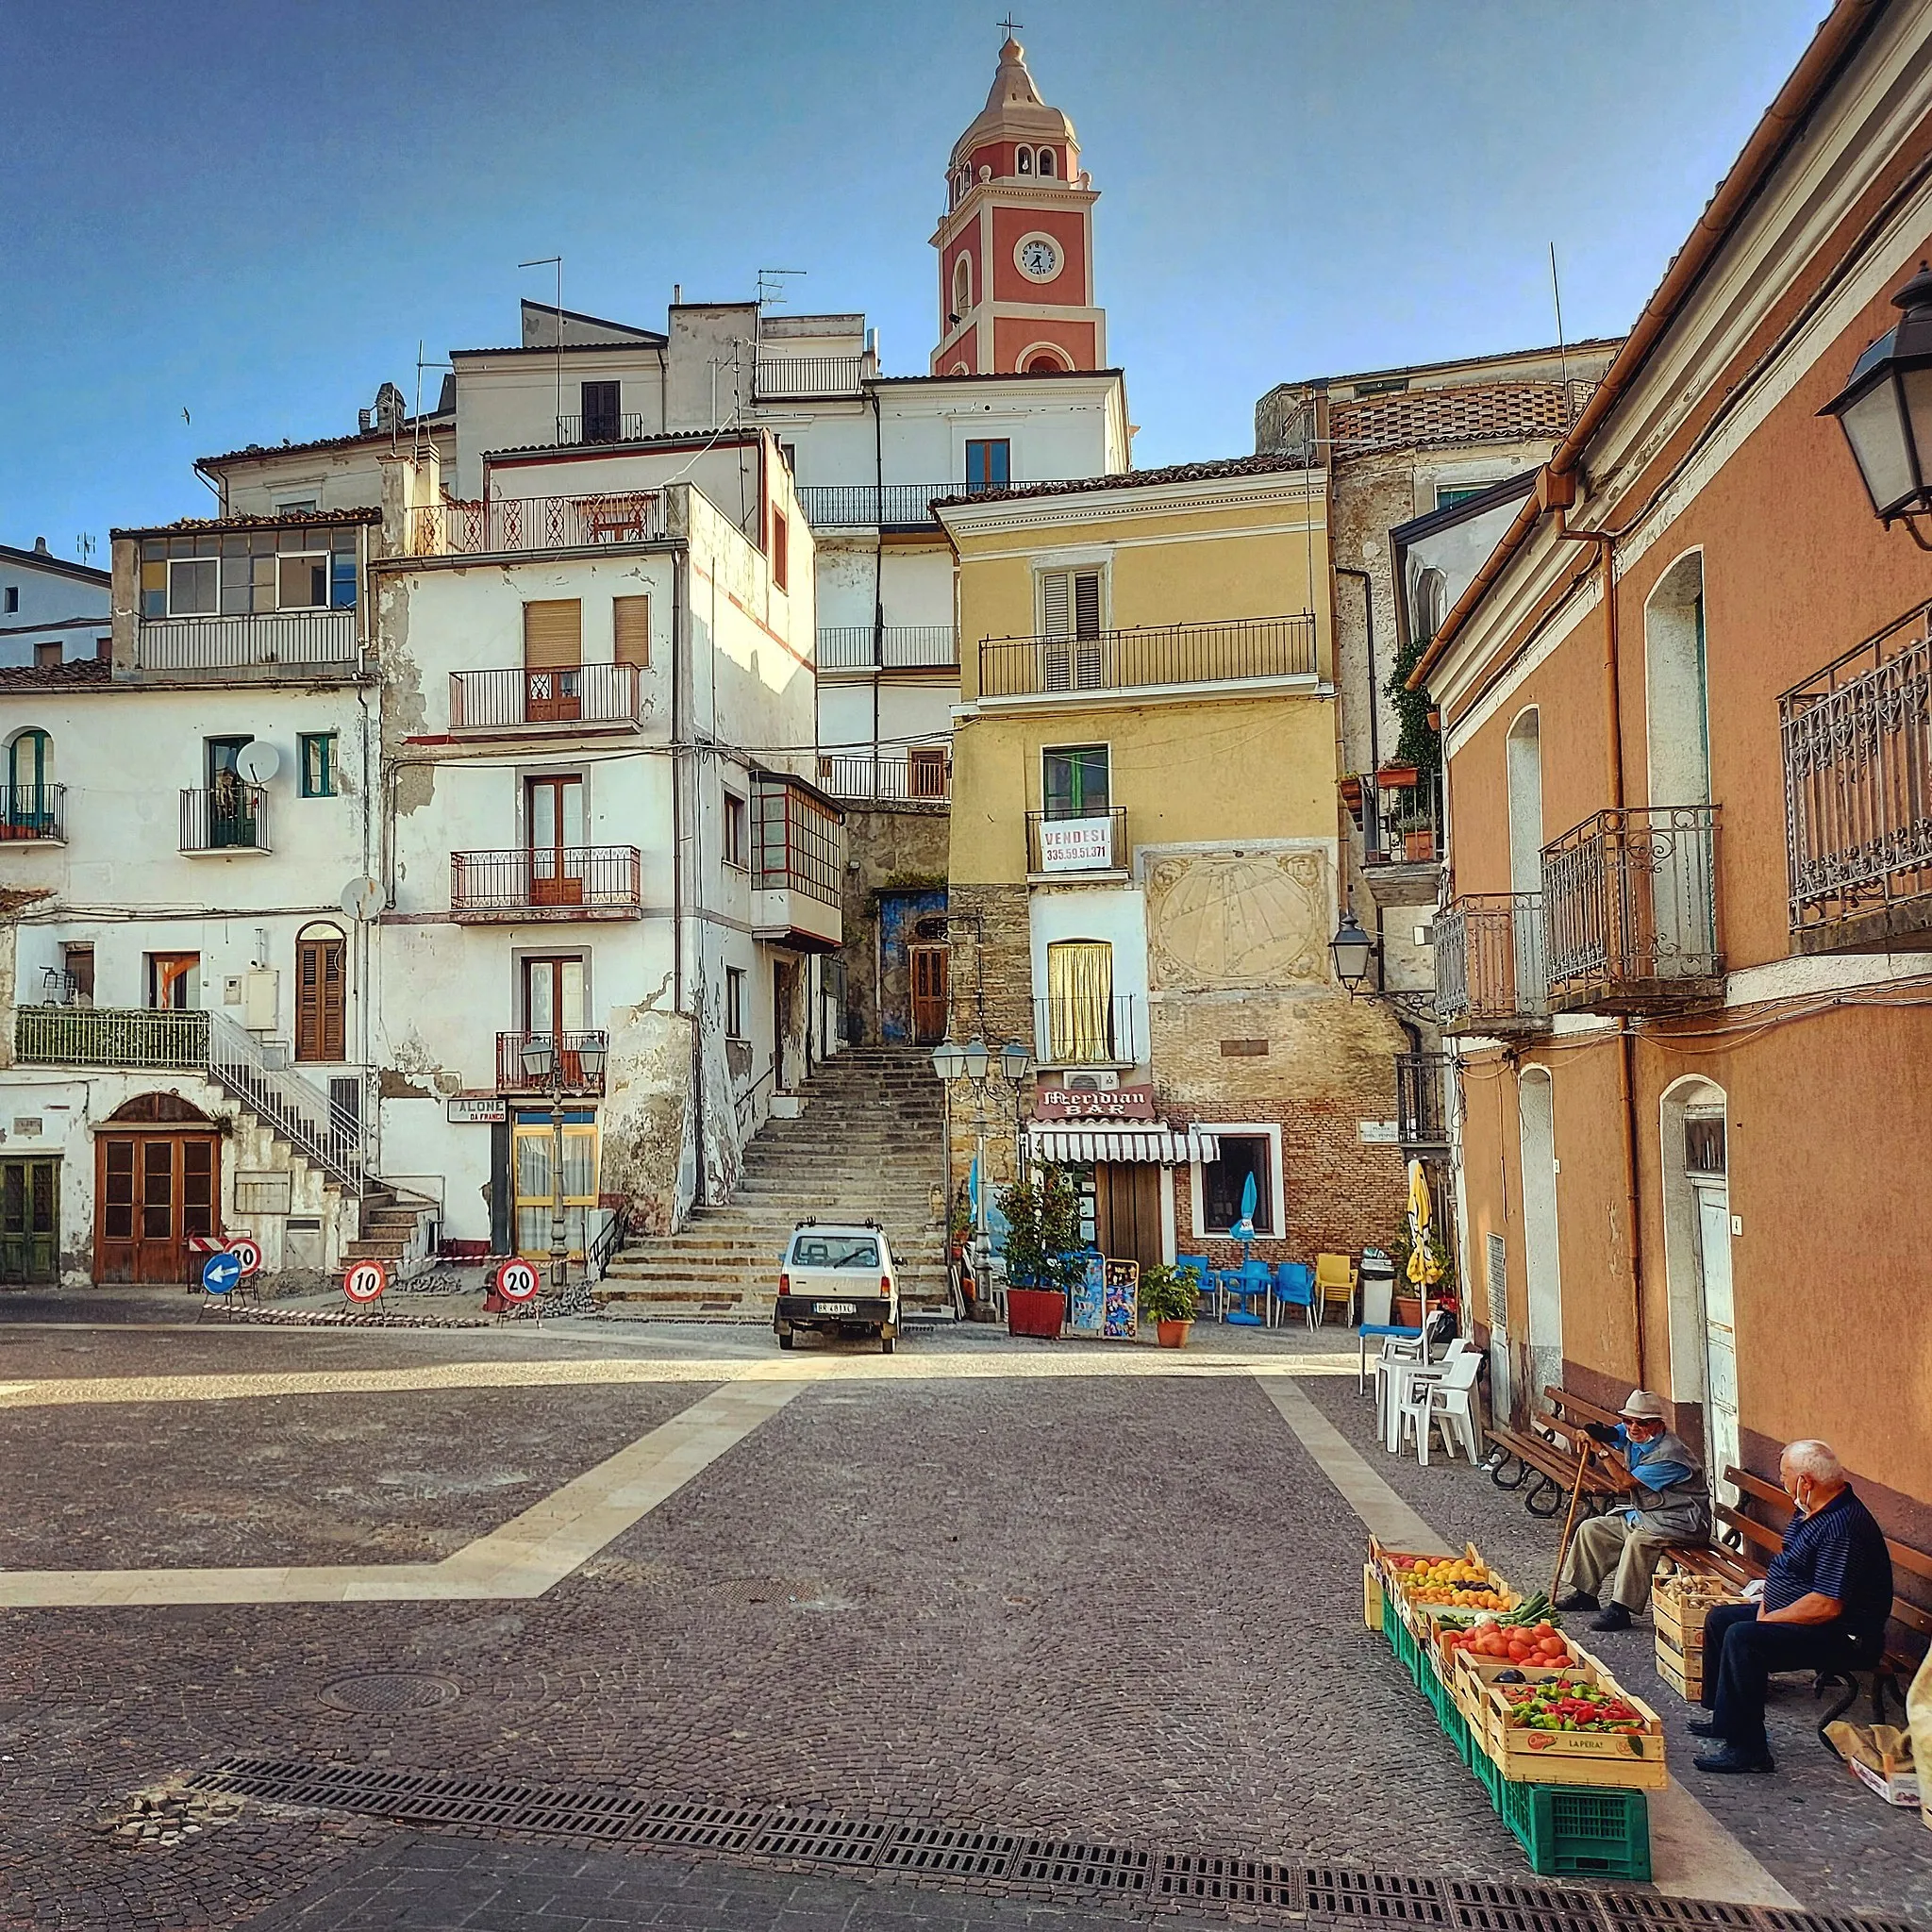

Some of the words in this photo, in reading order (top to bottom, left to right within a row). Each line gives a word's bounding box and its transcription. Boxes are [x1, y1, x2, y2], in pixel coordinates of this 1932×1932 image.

[1045, 829, 1105, 845] VENDESI
[1047, 845, 1106, 860] 335.59.51.371
[1043, 1091, 1145, 1106] Meridian
[459, 1101, 504, 1112] ALONE
[1064, 1105, 1125, 1115] BAR
[357, 1272, 376, 1291] 10
[508, 1271, 530, 1291] 20
